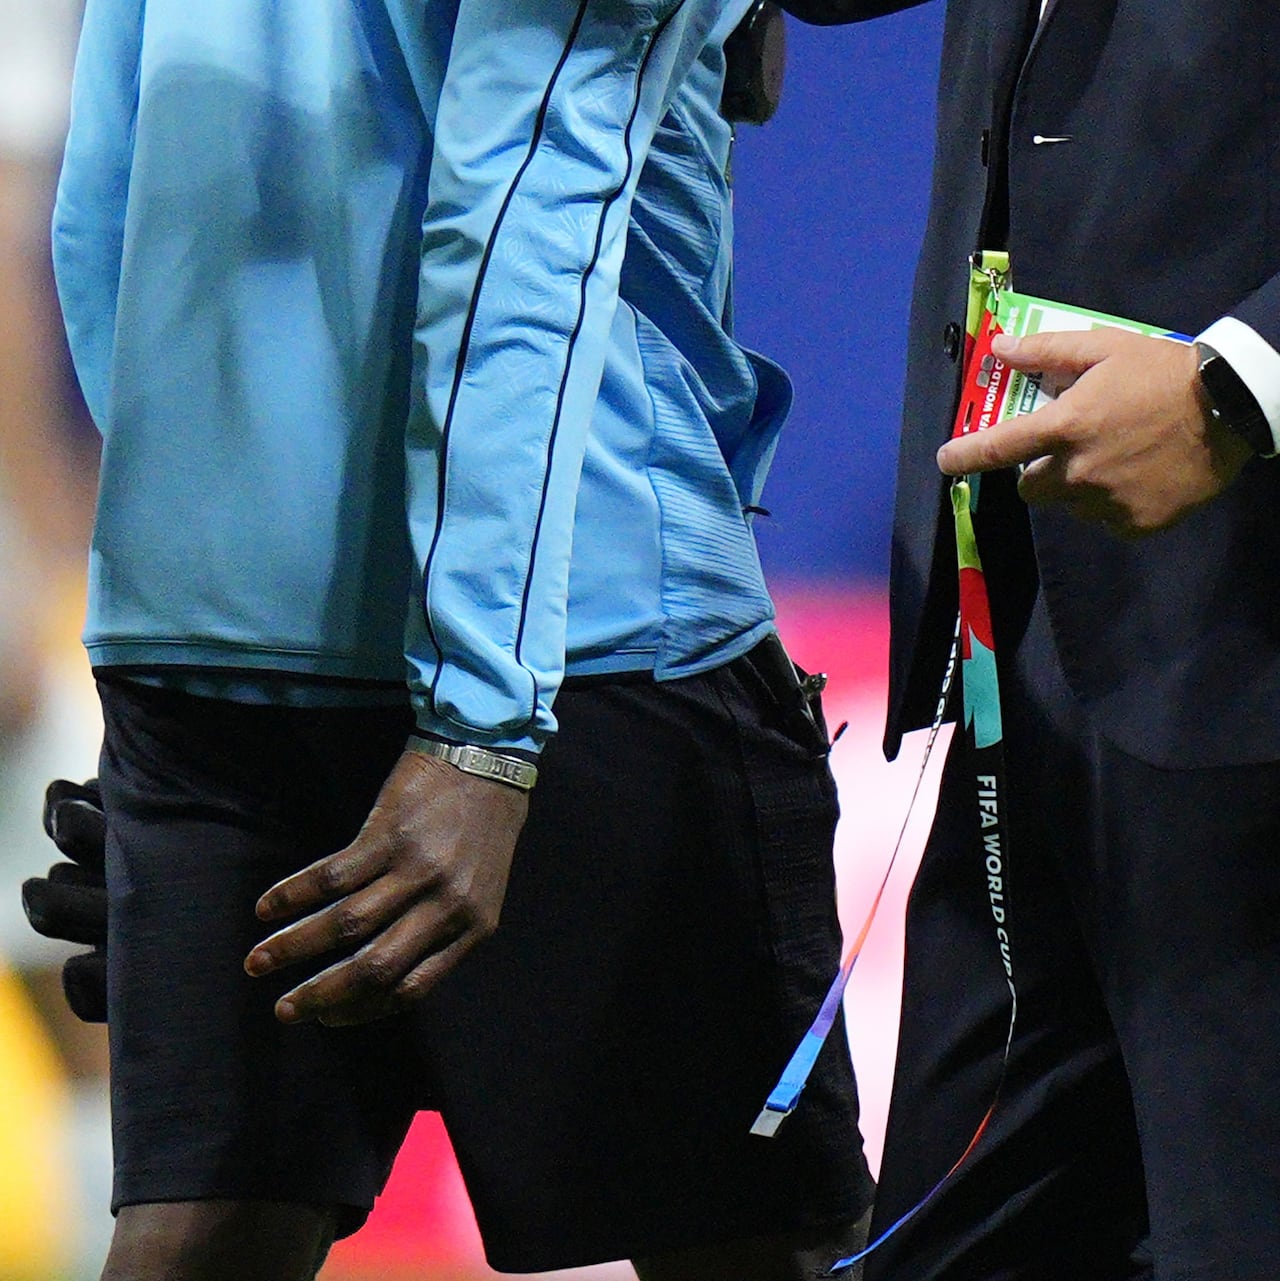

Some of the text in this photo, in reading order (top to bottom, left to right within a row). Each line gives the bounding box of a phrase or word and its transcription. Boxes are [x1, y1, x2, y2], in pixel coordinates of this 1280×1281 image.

[982, 371, 1002, 413] WORLD
[976, 775, 999, 829] FIFA
[983, 833, 1005, 924] WORLD
[996, 927, 1012, 978] CUP
